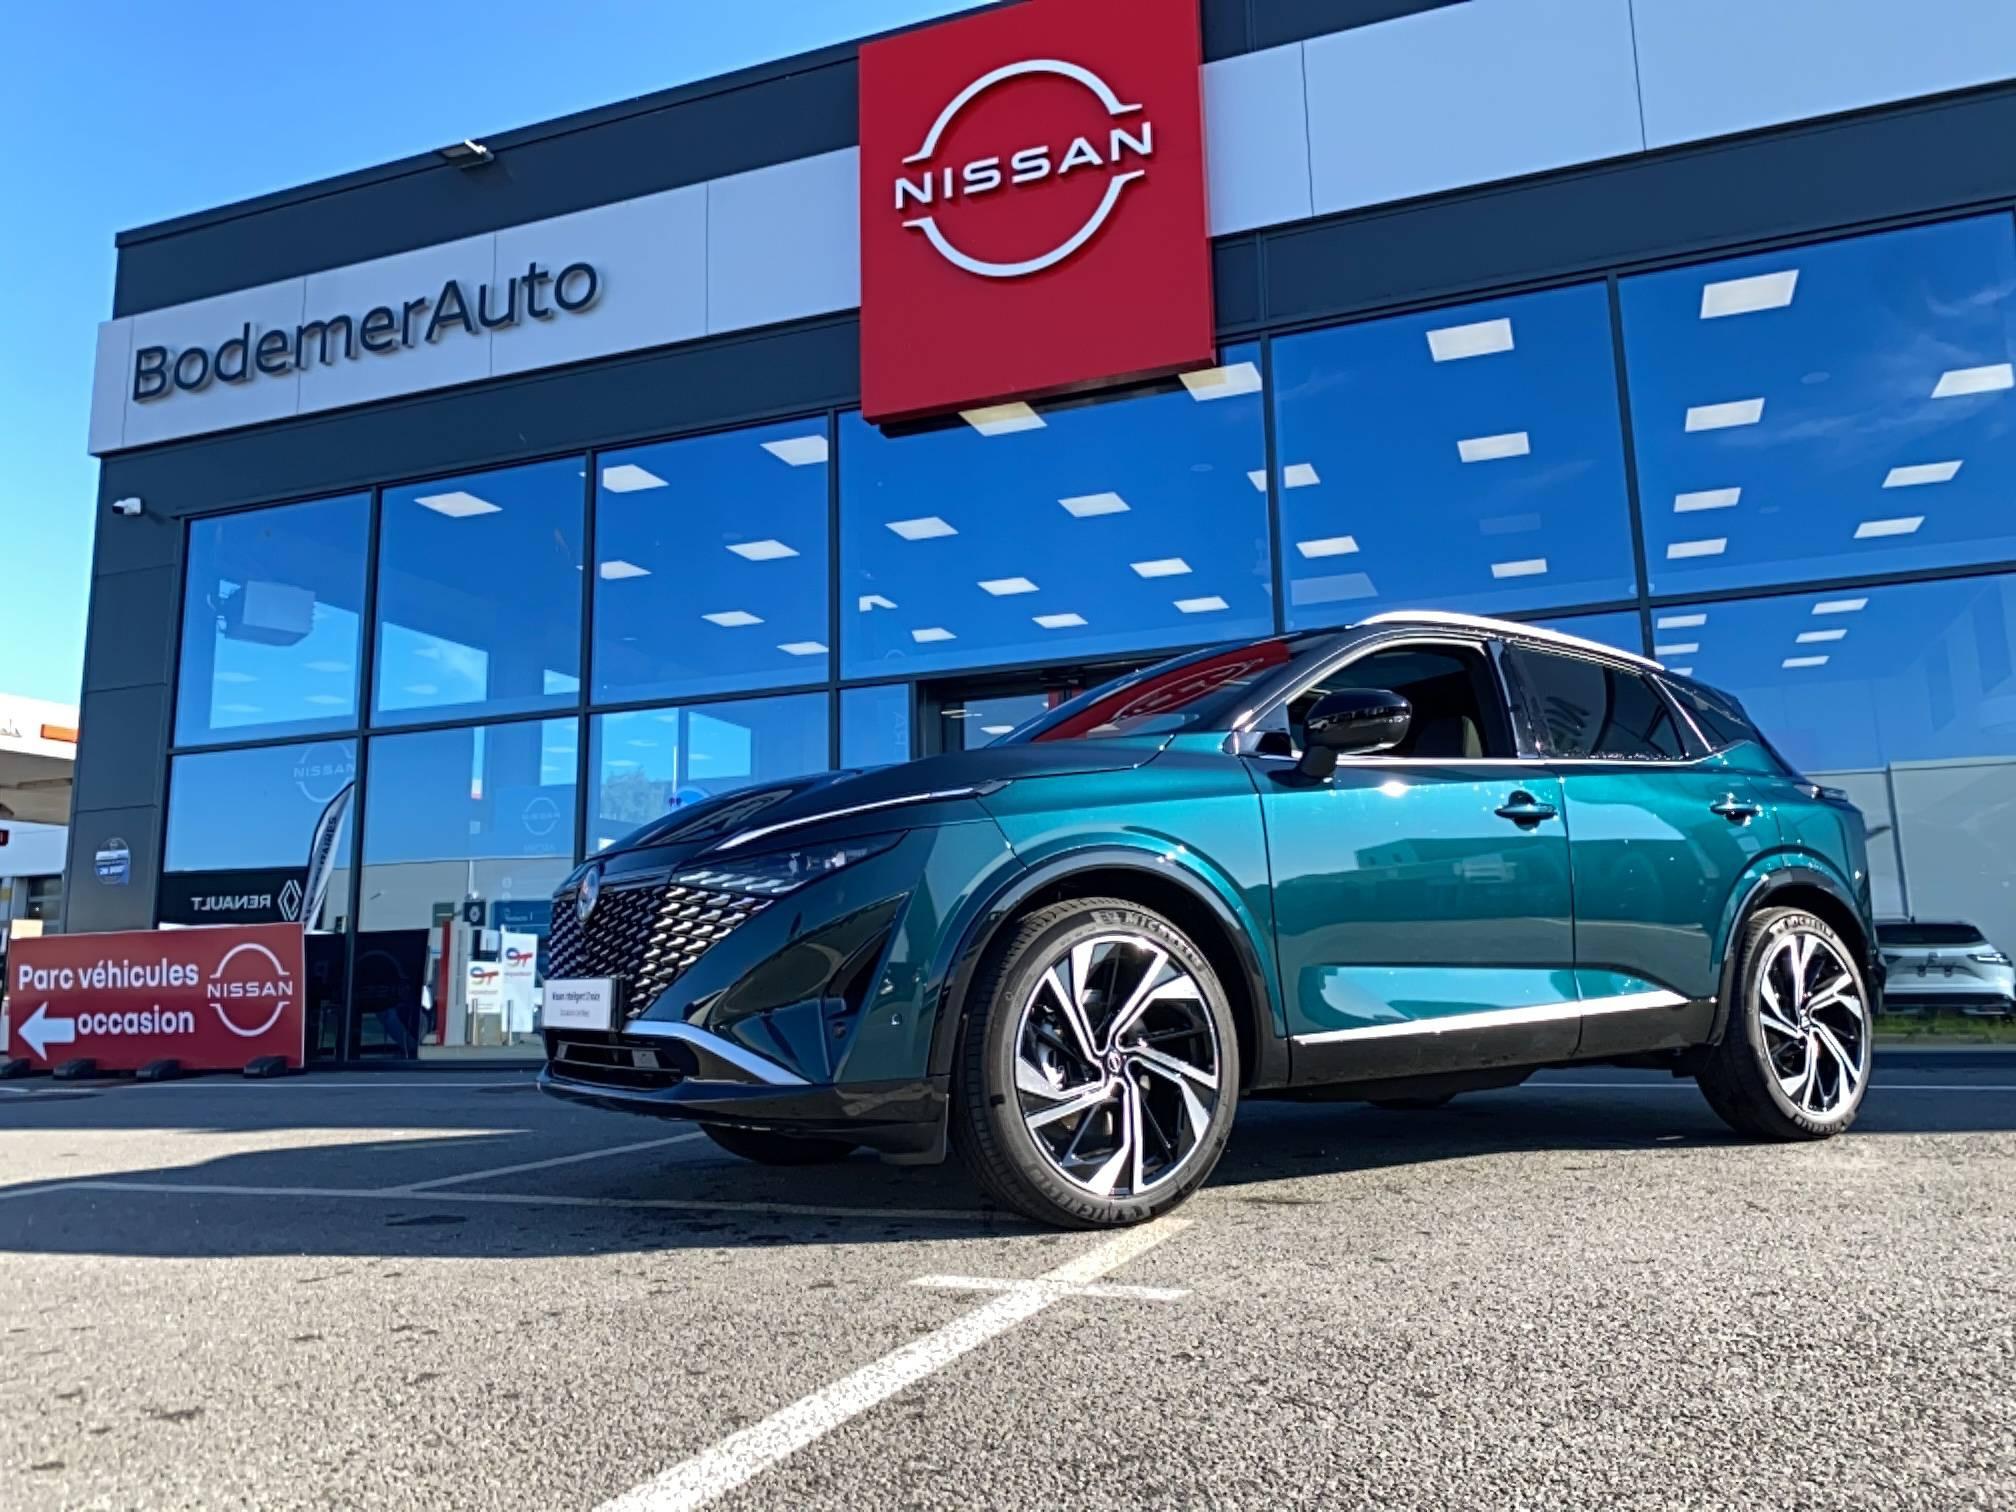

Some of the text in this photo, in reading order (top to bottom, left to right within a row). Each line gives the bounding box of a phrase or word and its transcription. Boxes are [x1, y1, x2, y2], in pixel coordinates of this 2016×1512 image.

[895, 121, 1152, 210] NISSAN
[132, 261, 599, 402] BodemerAuto
[18, 957, 199, 991] Parc véhicules
[206, 980, 293, 999] NISSAN
[77, 1004, 194, 1035] occasion
